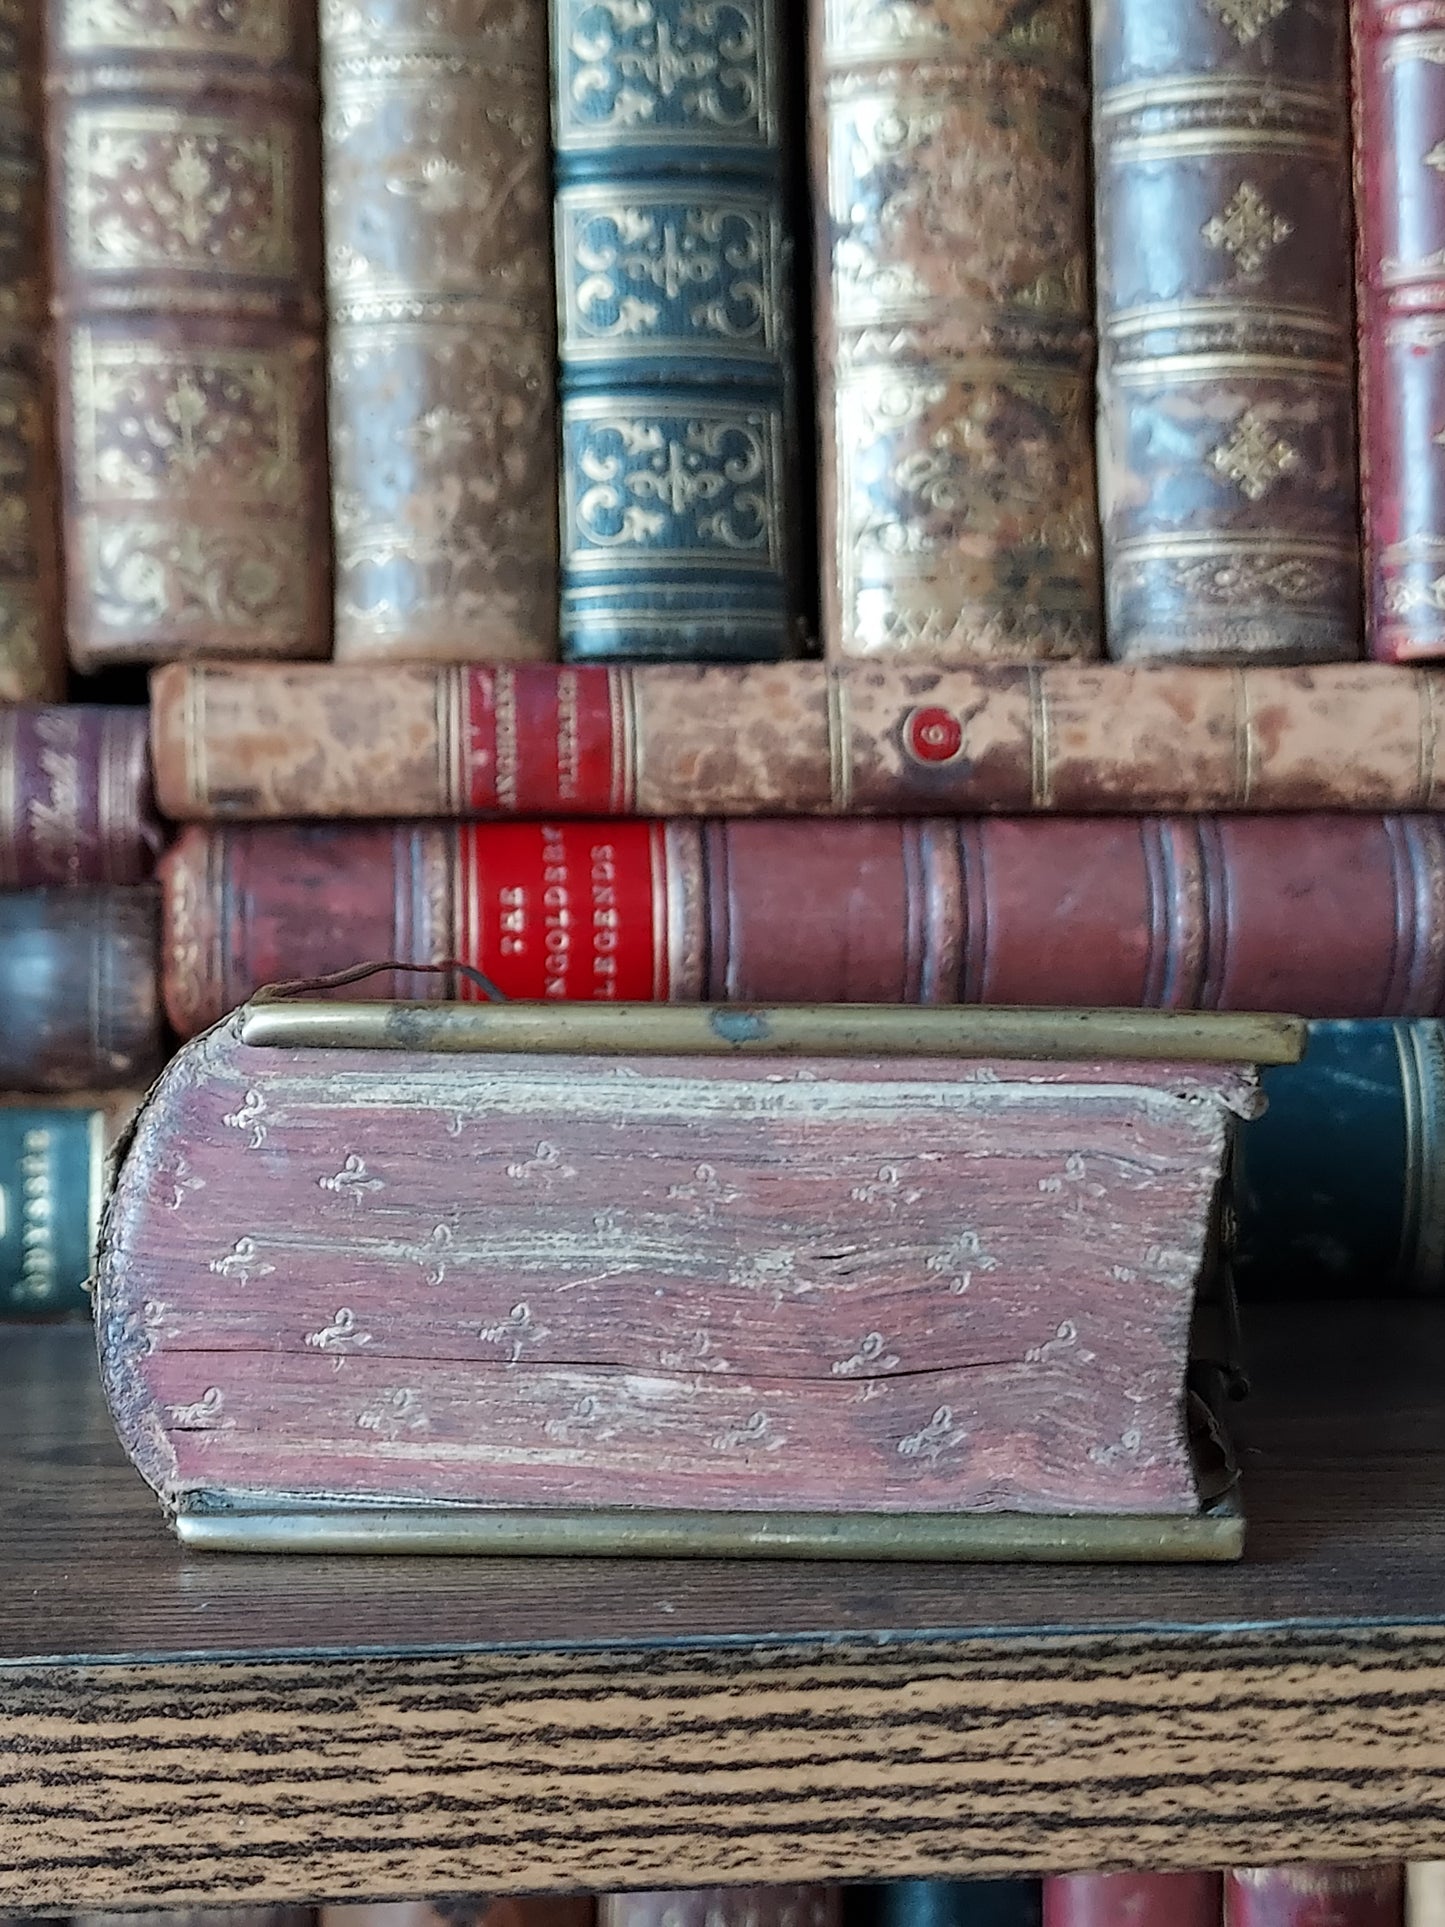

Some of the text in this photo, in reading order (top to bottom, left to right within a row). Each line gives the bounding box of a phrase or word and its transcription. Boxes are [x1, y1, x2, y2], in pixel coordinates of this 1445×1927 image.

[500, 886, 525, 955] THE
[542, 824, 570, 998] NGOLDSBY
[591, 844, 617, 997] LEGENDS
